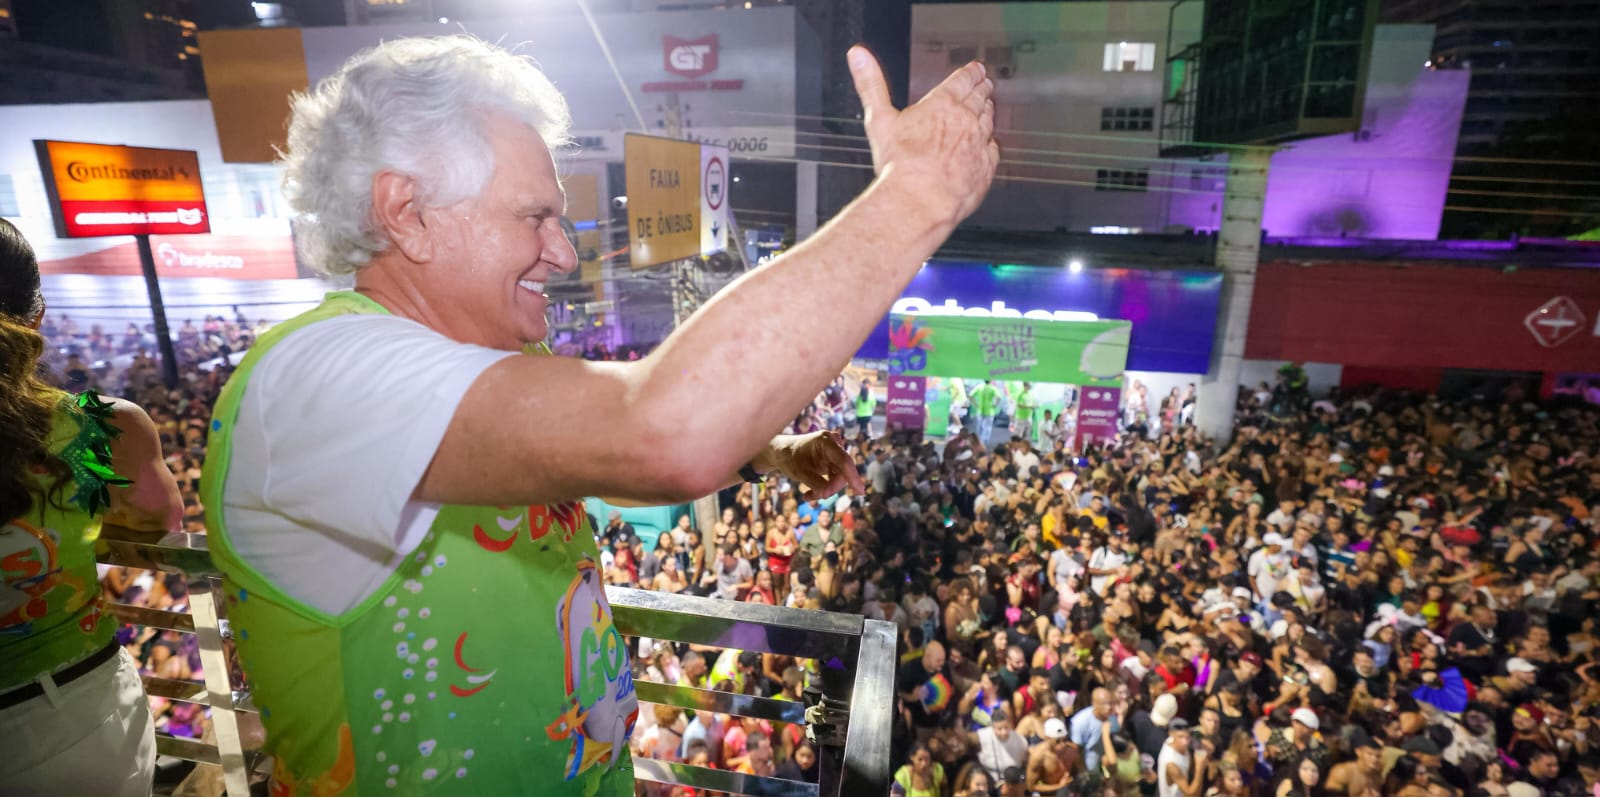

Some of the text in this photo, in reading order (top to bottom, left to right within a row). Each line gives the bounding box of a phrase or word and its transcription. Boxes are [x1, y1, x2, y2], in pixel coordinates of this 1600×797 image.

[669, 45, 710, 70] GT
[727, 137, 769, 152] 0006
[67, 161, 177, 183] Continental
[650, 168, 680, 189] FAIXA
[637, 210, 693, 239] DE ÔNIBUS
[580, 624, 625, 709] GO
